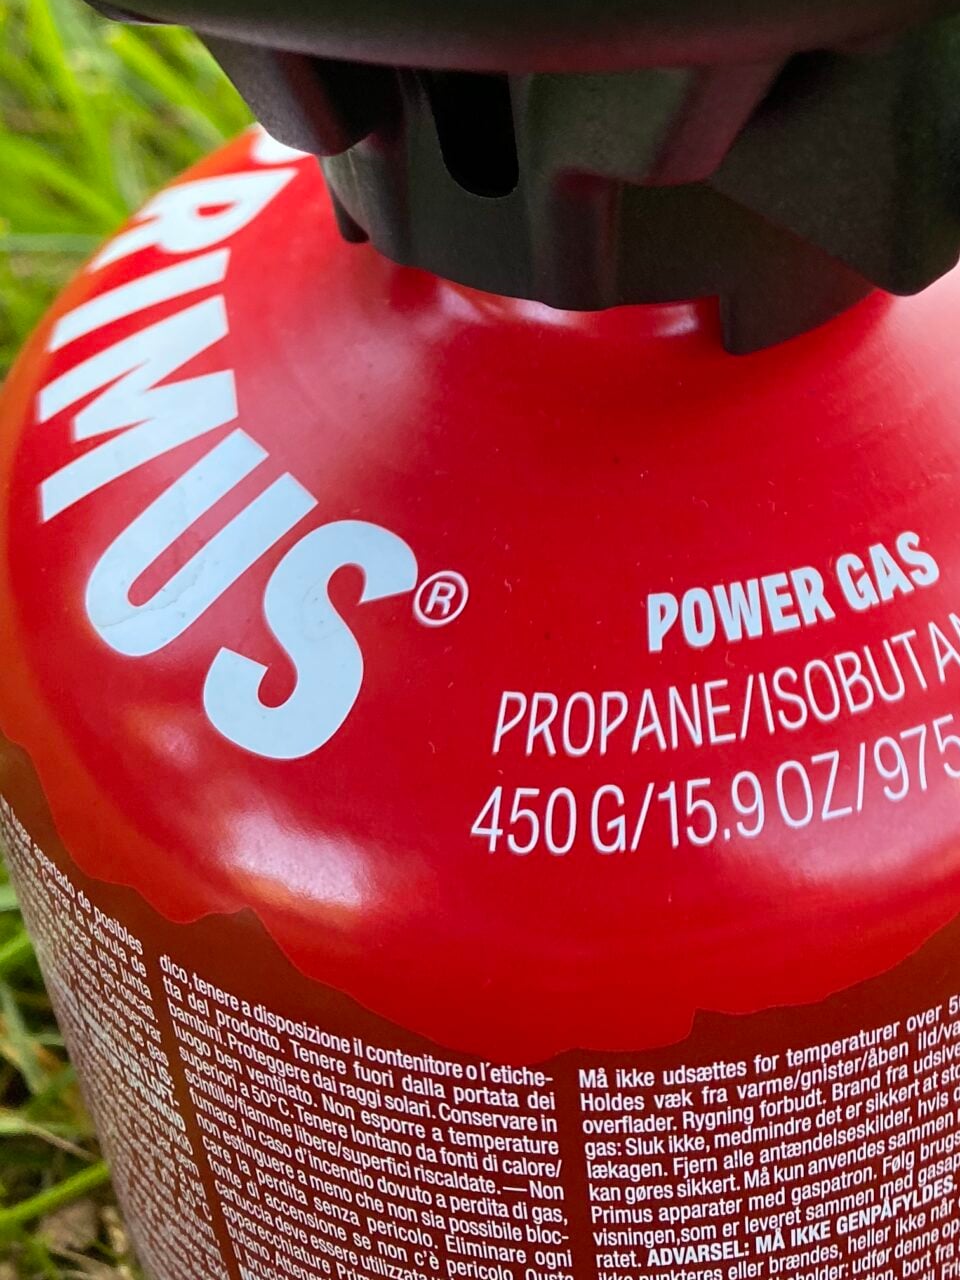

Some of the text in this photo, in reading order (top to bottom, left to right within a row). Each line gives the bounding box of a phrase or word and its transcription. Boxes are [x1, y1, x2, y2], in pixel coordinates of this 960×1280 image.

[38, 123, 419, 761] RIMUS
[648, 531, 941, 653] POWER GAS
[94, 906, 144, 956] posibles
[131, 954, 147, 978] de
[162, 975, 555, 1110] tta del prodotto. Tenere fuori dalla portata dei
[241, 1000, 252, 1017] a
[253, 1003, 350, 1053] disposizione
[352, 1037, 363, 1057] il
[365, 1045, 462, 1078] contenitore
[578, 1069, 608, 1088] Må
[616, 1068, 654, 1087] ikke
[662, 1060, 746, 1085] udsættes
[753, 1054, 779, 1073] for
[785, 1021, 900, 1067] temperaturer
[906, 1004, 942, 1032] over
[580, 1092, 644, 1111] Holdes
[653, 1088, 693, 1108] væk
[701, 1085, 727, 1104] fra
[736, 1041, 908, 1099] varme/gnister/åben
[172, 1019, 558, 1155] luogo ben ventilato. Non esporre a temperature
[178, 1045, 561, 1177] superiori a 50°C. Tenere lontano da fonti di calore/
[312, 1070, 337, 1093] dai
[339, 1082, 381, 1108] raggi
[384, 1094, 436, 1118] solari.
[438, 1102, 537, 1131] Conservare
[540, 1114, 557, 1132] in
[582, 1113, 677, 1134] overflader.
[682, 1105, 753, 1131] Rygning
[759, 1087, 826, 1118] forbudt.
[831, 1069, 880, 1101] Brand
[885, 1064, 908, 1084] fra
[584, 1141, 621, 1160] gas:
[625, 1136, 665, 1155] Sluk
[668, 1133, 710, 1153] ikke,
[714, 1116, 811, 1148] medmindre
[815, 1105, 842, 1128] det
[845, 1101, 862, 1119] er
[865, 1078, 919, 1113] sikkert
[922, 1070, 938, 1093] at
[184, 1068, 564, 1200] scintille/fiamme libere/superfici riscaldate. Non
[241, 1117, 256, 1140] In
[258, 1130, 292, 1157] caso
[370, 1175, 432, 1204] dovuto
[435, 1193, 447, 1208] a
[449, 1195, 509, 1217] perdita
[512, 1201, 527, 1219] di
[531, 1206, 567, 1225] gas,
[586, 1160, 667, 1182] lækagen.
[673, 1156, 717, 1178] Fjern
[723, 1148, 753, 1169] alle
[759, 1106, 912, 1163] antændelseskilder,
[917, 1091, 948, 1117] hvis
[588, 1183, 620, 1201] kan
[624, 1184, 673, 1204] gøres
[676, 1173, 740, 1197] sikkert.
[743, 1166, 770, 1188] Må
[773, 1163, 804, 1183] kun
[807, 1139, 885, 1175] anvendes
[888, 1111, 953, 1150] sammen
[591, 1205, 653, 1223] Primus
[658, 1198, 742, 1224] apparater
[748, 1186, 785, 1210] med
[791, 1166, 877, 1205] gaspatron.
[882, 1150, 914, 1175] Følg
[595, 1250, 641, 1268] ratet.
[646, 1240, 749, 1266] ADVARSEL:
[755, 1229, 785, 1254] MÅ
[790, 1219, 830, 1246] IKKE
[836, 1174, 957, 1234] GENPÅFYLDES.
[722, 1221, 739, 1237] er
[744, 1206, 801, 1233] leveret
[805, 1187, 874, 1220] sammen
[879, 1168, 913, 1203] med
